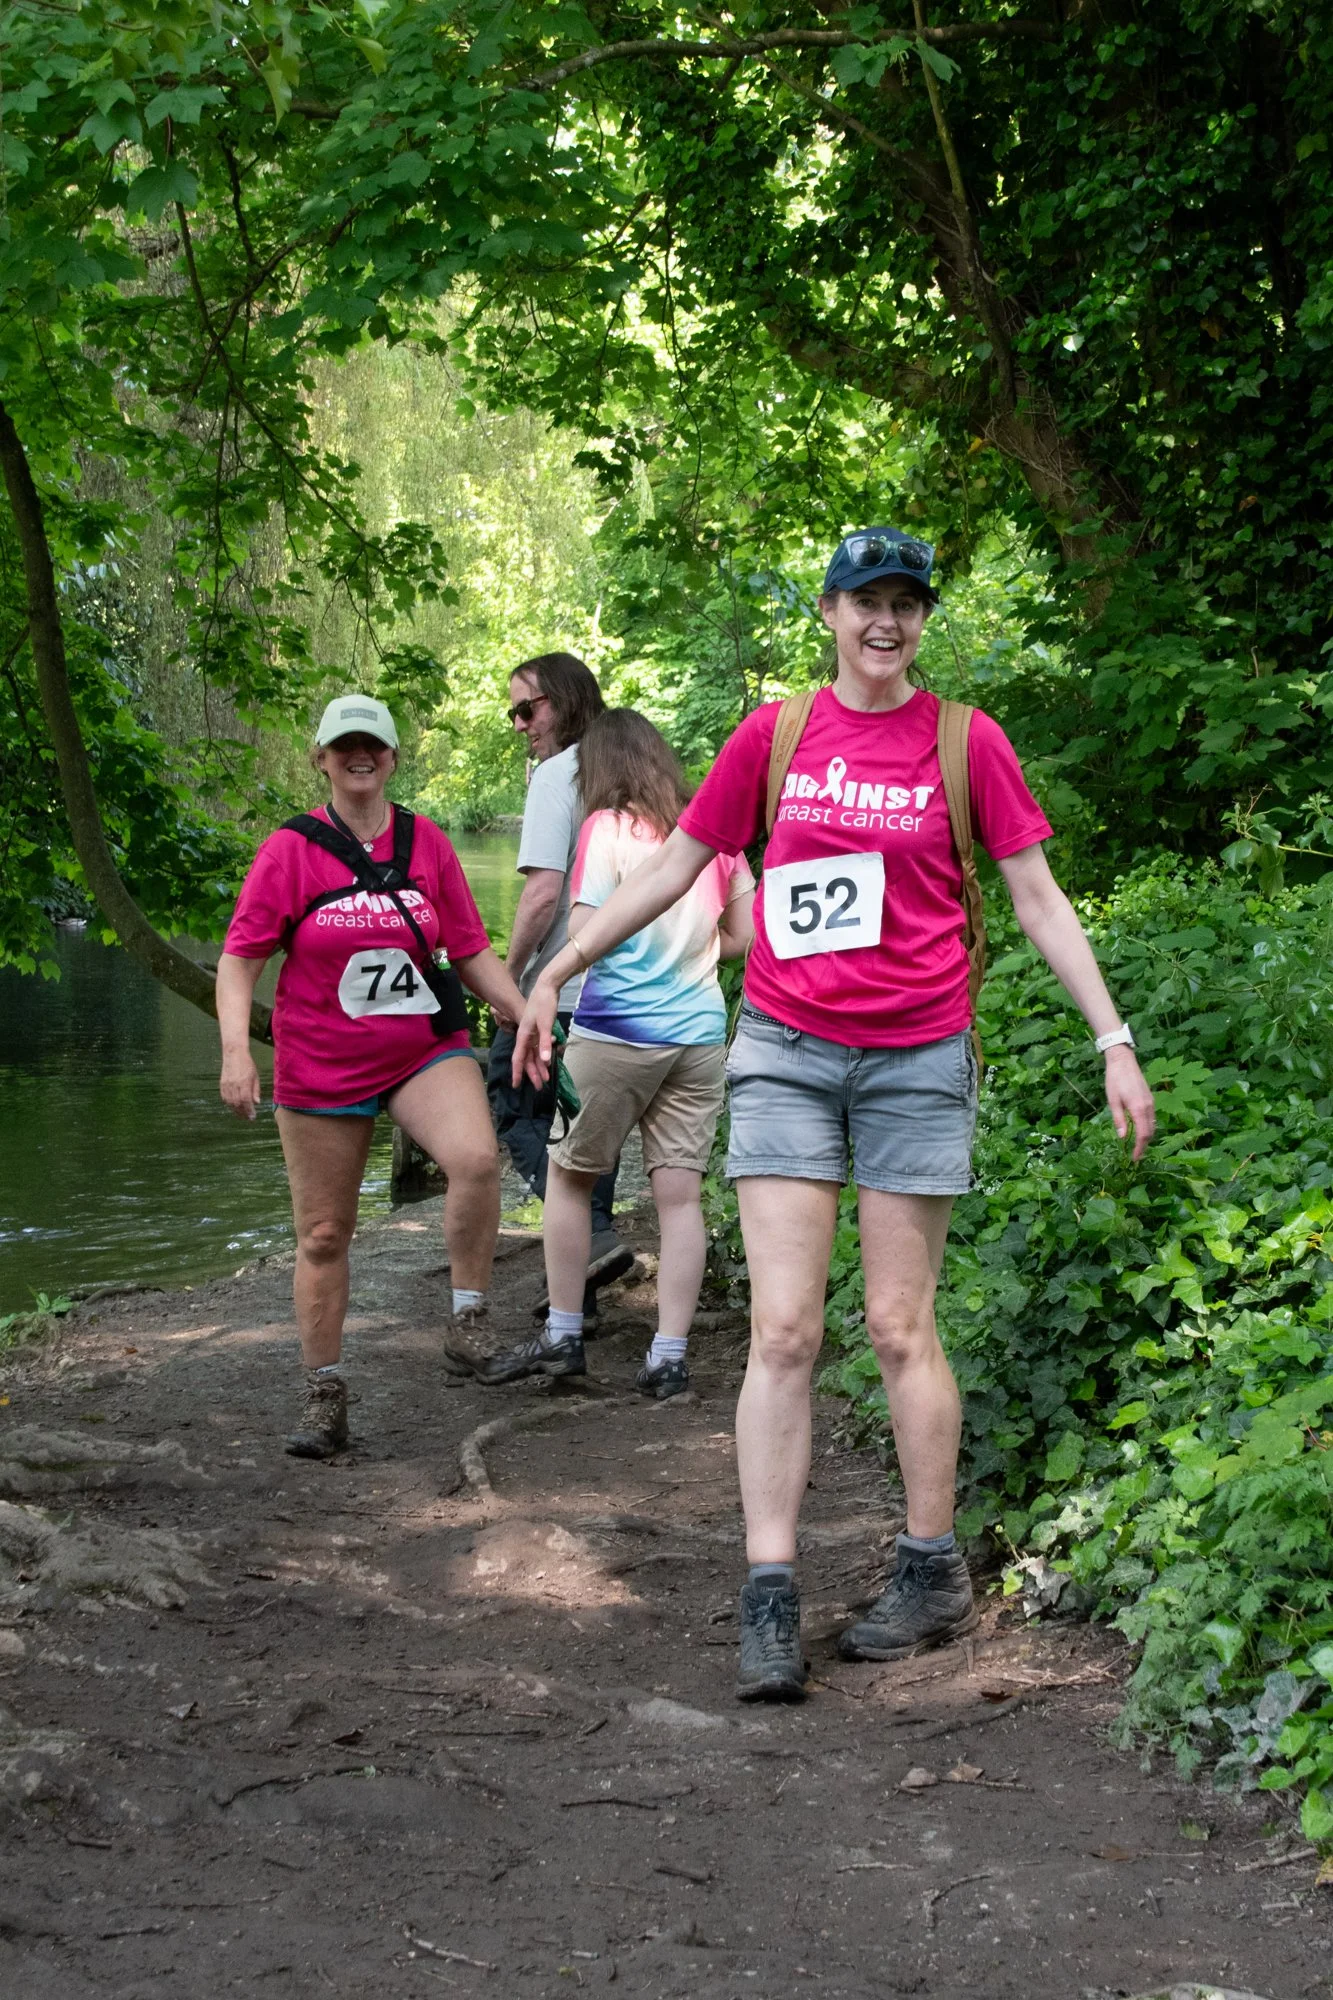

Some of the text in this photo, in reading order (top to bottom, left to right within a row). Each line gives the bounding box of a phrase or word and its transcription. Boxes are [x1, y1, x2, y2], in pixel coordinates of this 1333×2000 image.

[839, 811, 923, 832] cancer
[316, 911, 374, 928] breast
[789, 877, 861, 935] 52
[361, 963, 419, 1001] 74
